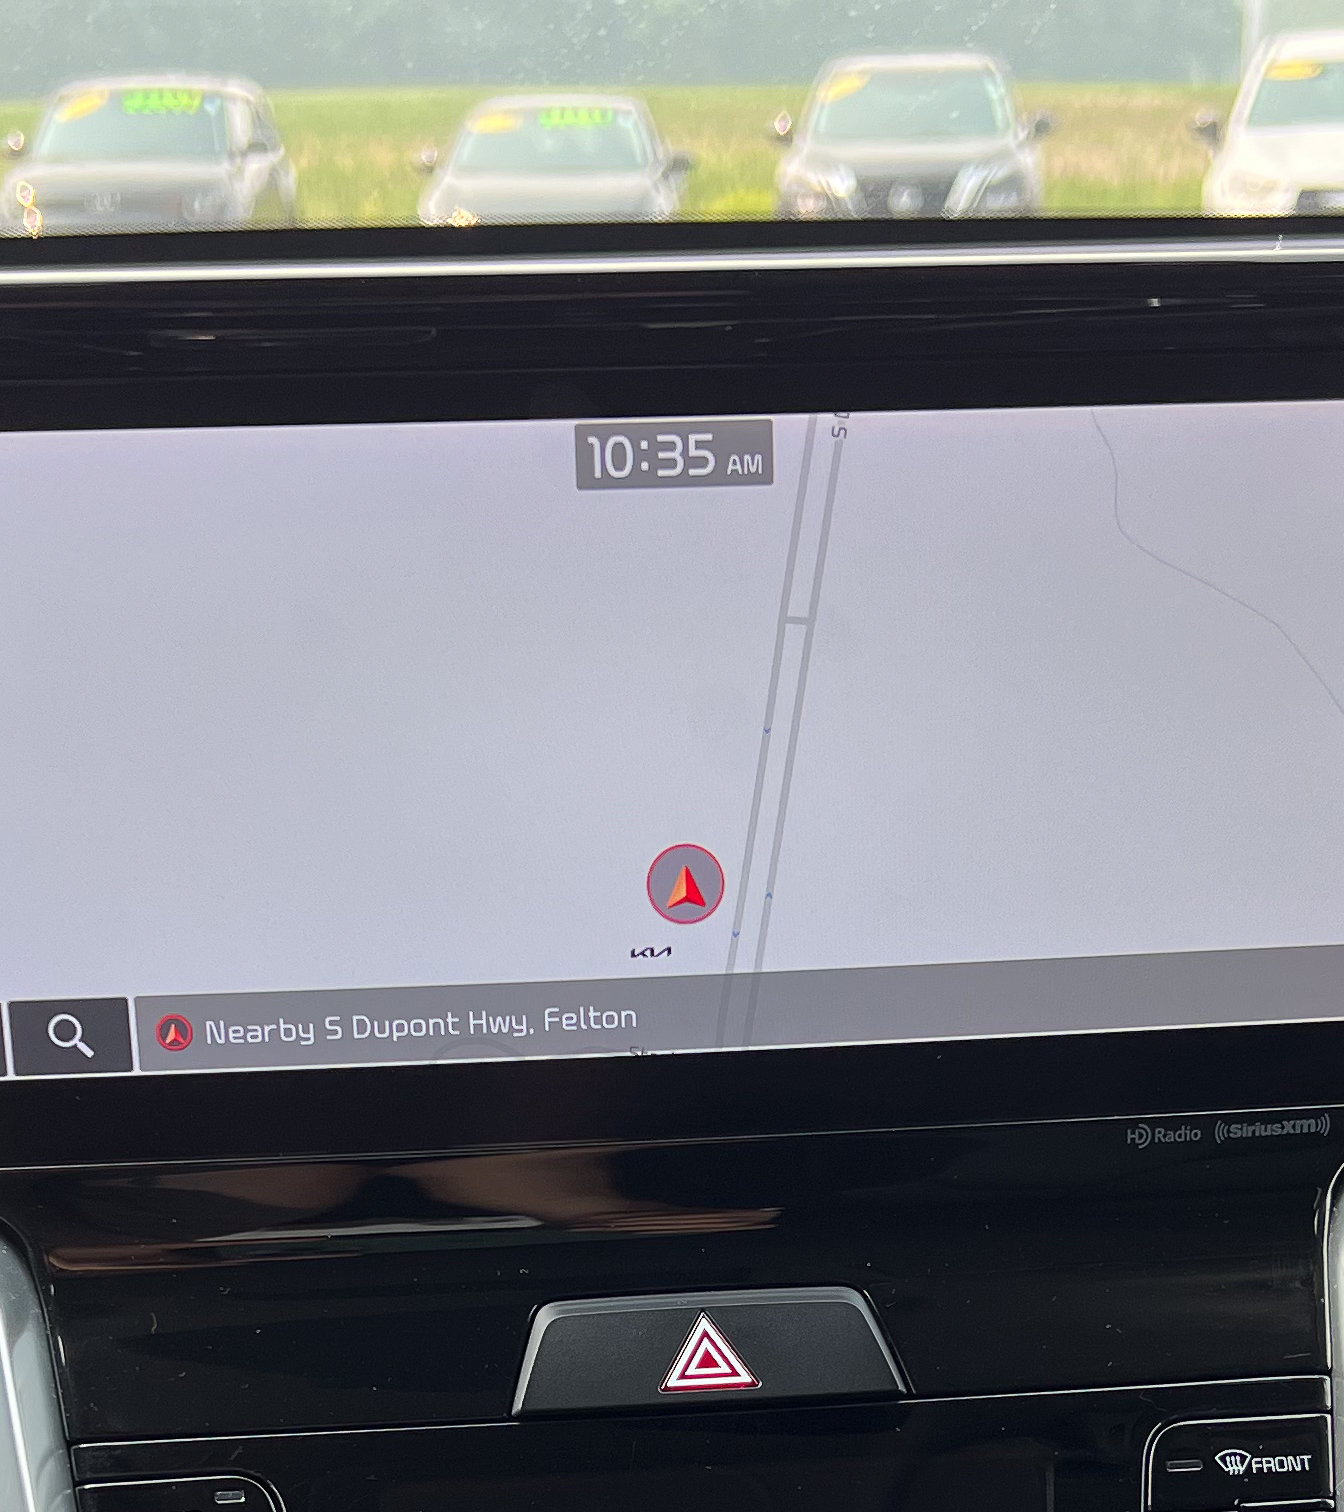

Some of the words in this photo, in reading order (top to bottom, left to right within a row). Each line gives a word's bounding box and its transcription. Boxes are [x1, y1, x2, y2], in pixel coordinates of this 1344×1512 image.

[587, 433, 716, 479] 10:35
[726, 453, 763, 476] AM
[205, 1015, 316, 1046] Nearby
[325, 1016, 344, 1041] S
[352, 1011, 460, 1043] Dupont
[544, 1006, 638, 1033] Felton
[1154, 1125, 1202, 1143] Radio
[1251, 1455, 1312, 1474] FRONT
